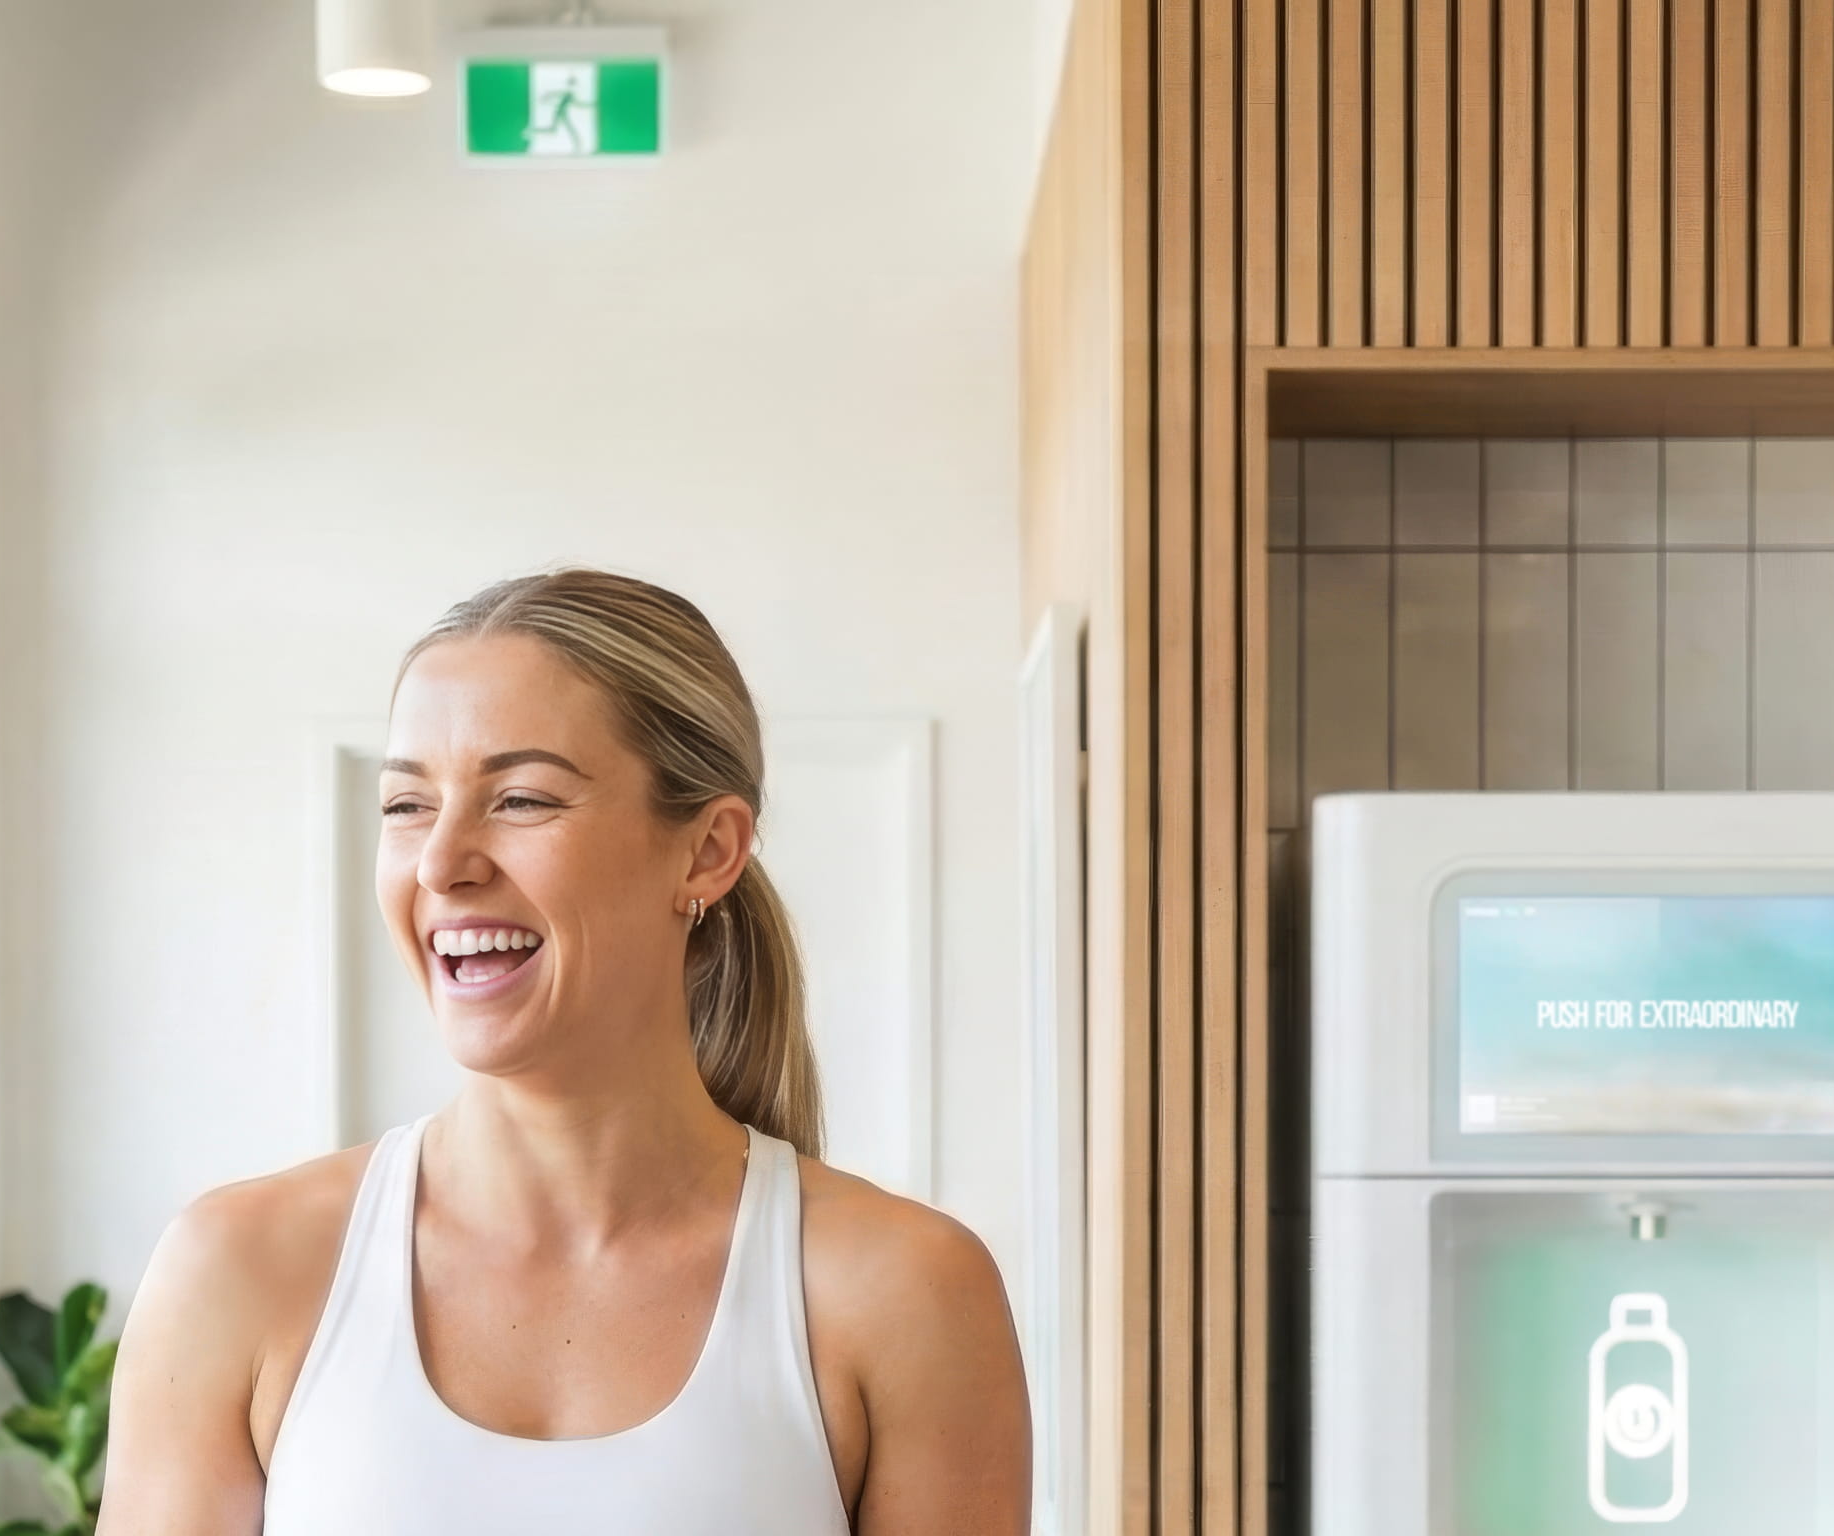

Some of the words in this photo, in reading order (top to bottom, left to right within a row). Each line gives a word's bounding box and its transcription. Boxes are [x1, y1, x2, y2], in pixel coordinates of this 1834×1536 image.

[1537, 1000, 1589, 1028] PUSH
[1595, 1000, 1633, 1028] FOR
[1639, 1000, 1799, 1028] EXTRAORDINARY
